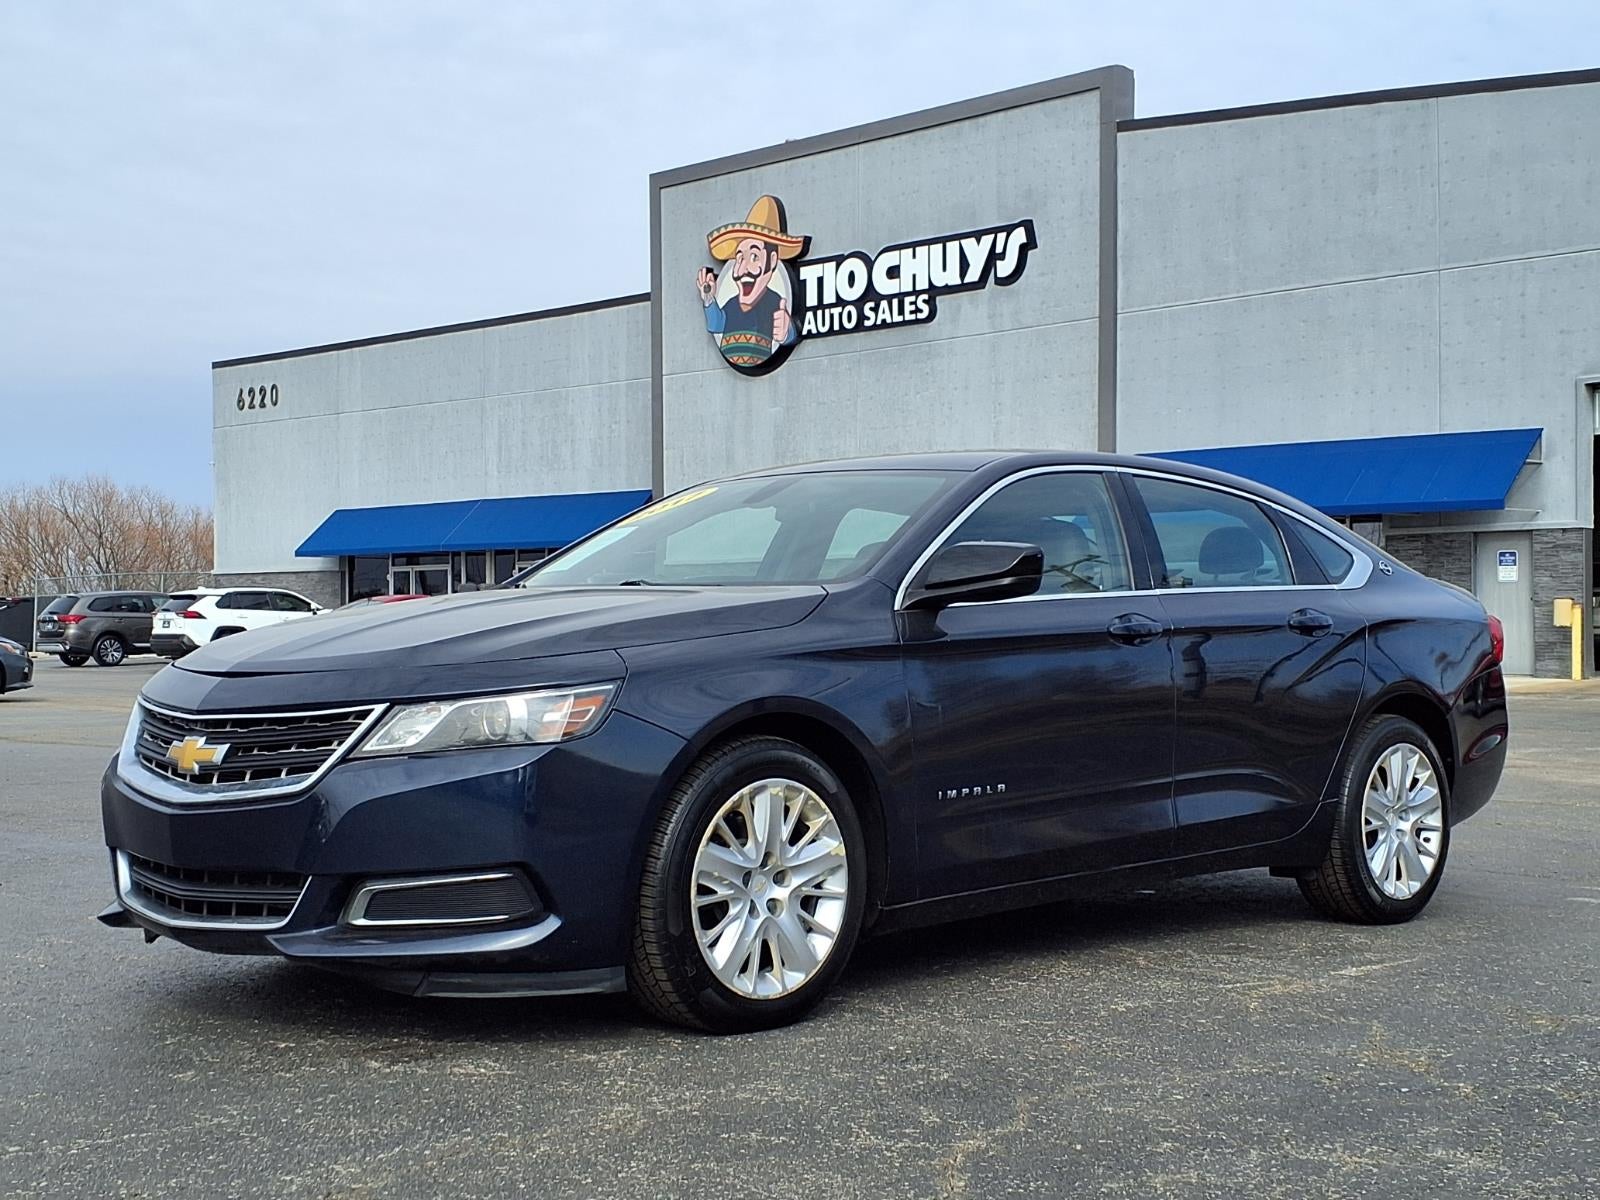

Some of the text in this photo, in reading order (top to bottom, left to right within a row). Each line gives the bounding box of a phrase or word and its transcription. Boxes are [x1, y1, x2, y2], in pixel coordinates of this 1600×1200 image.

[801, 227, 1027, 307] TIO CHUY'S
[803, 295, 929, 335] AUTO SALES
[237, 383, 279, 411] 6220
[938, 783, 1006, 800] IMPALA
